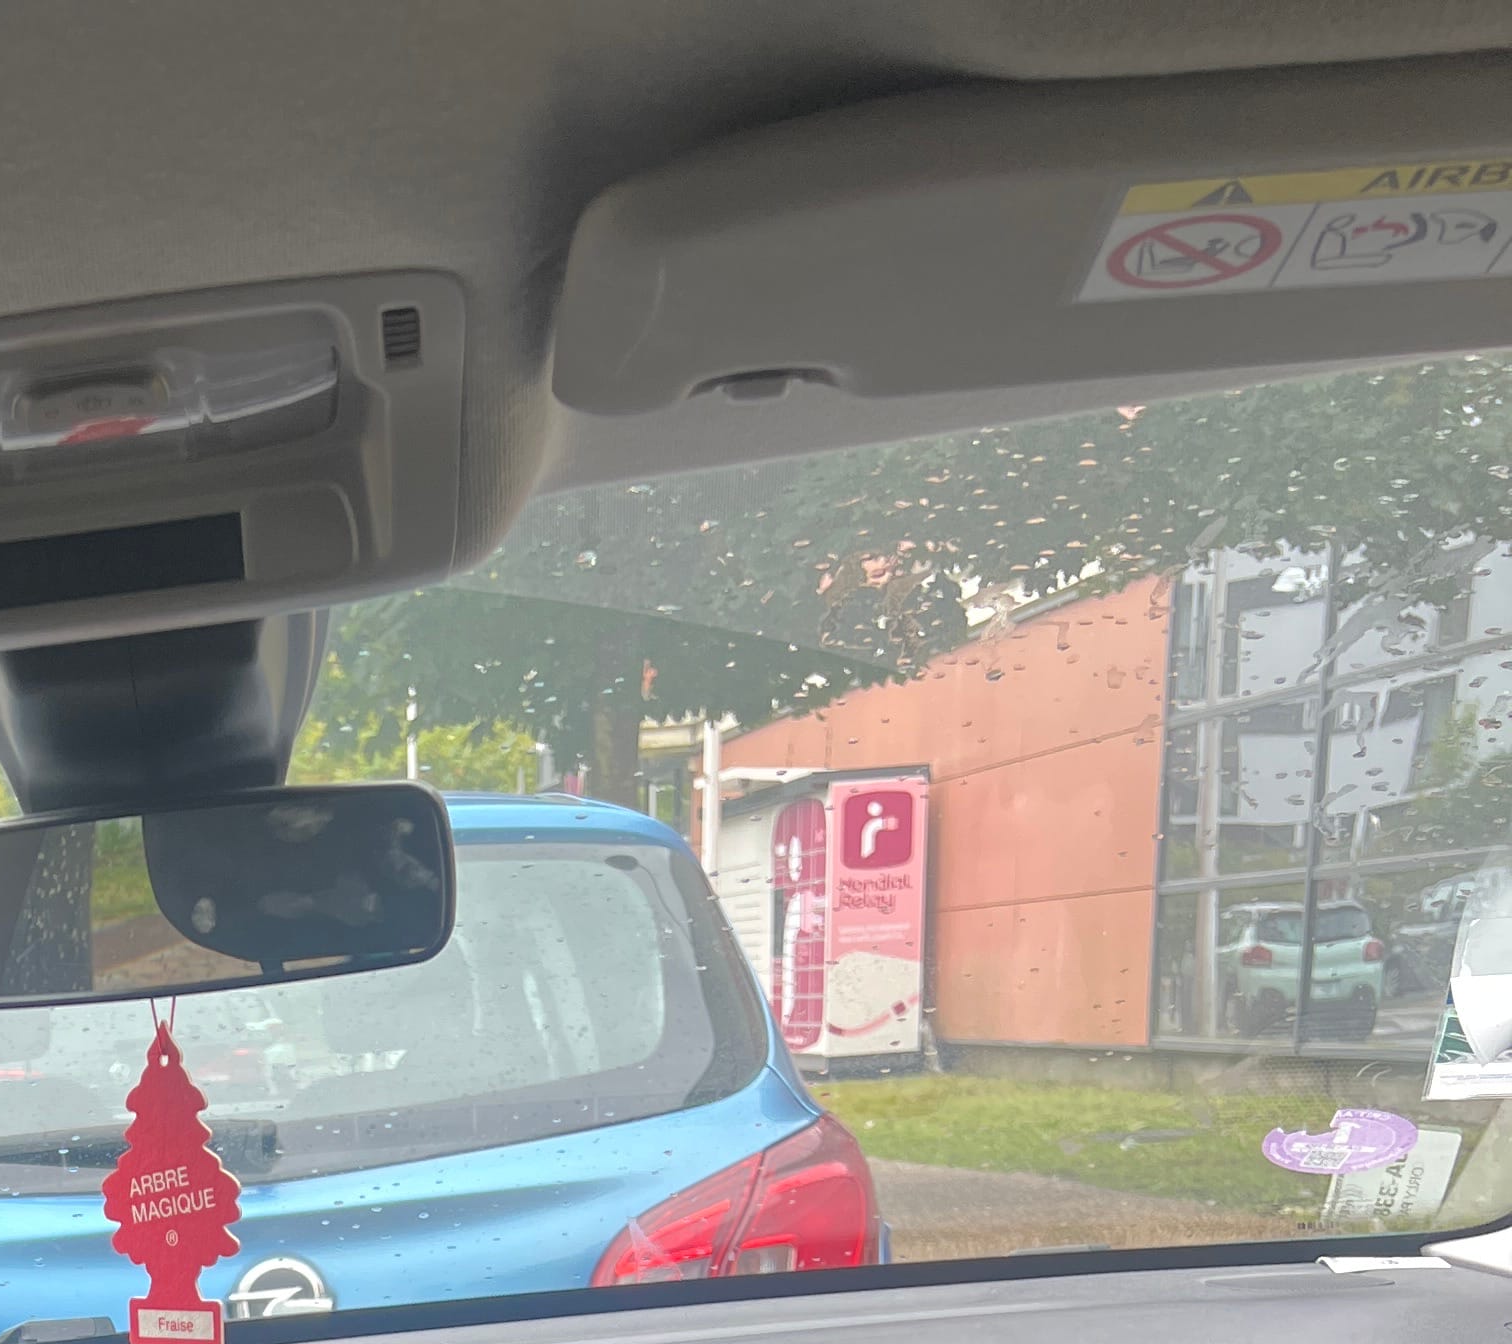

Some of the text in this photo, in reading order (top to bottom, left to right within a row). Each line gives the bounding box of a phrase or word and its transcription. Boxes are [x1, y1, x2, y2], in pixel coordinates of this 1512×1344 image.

[129, 1166, 190, 1198] ARBRE
[131, 1188, 217, 1224] MAGIQUE
[157, 1317, 194, 1333] Fraise
